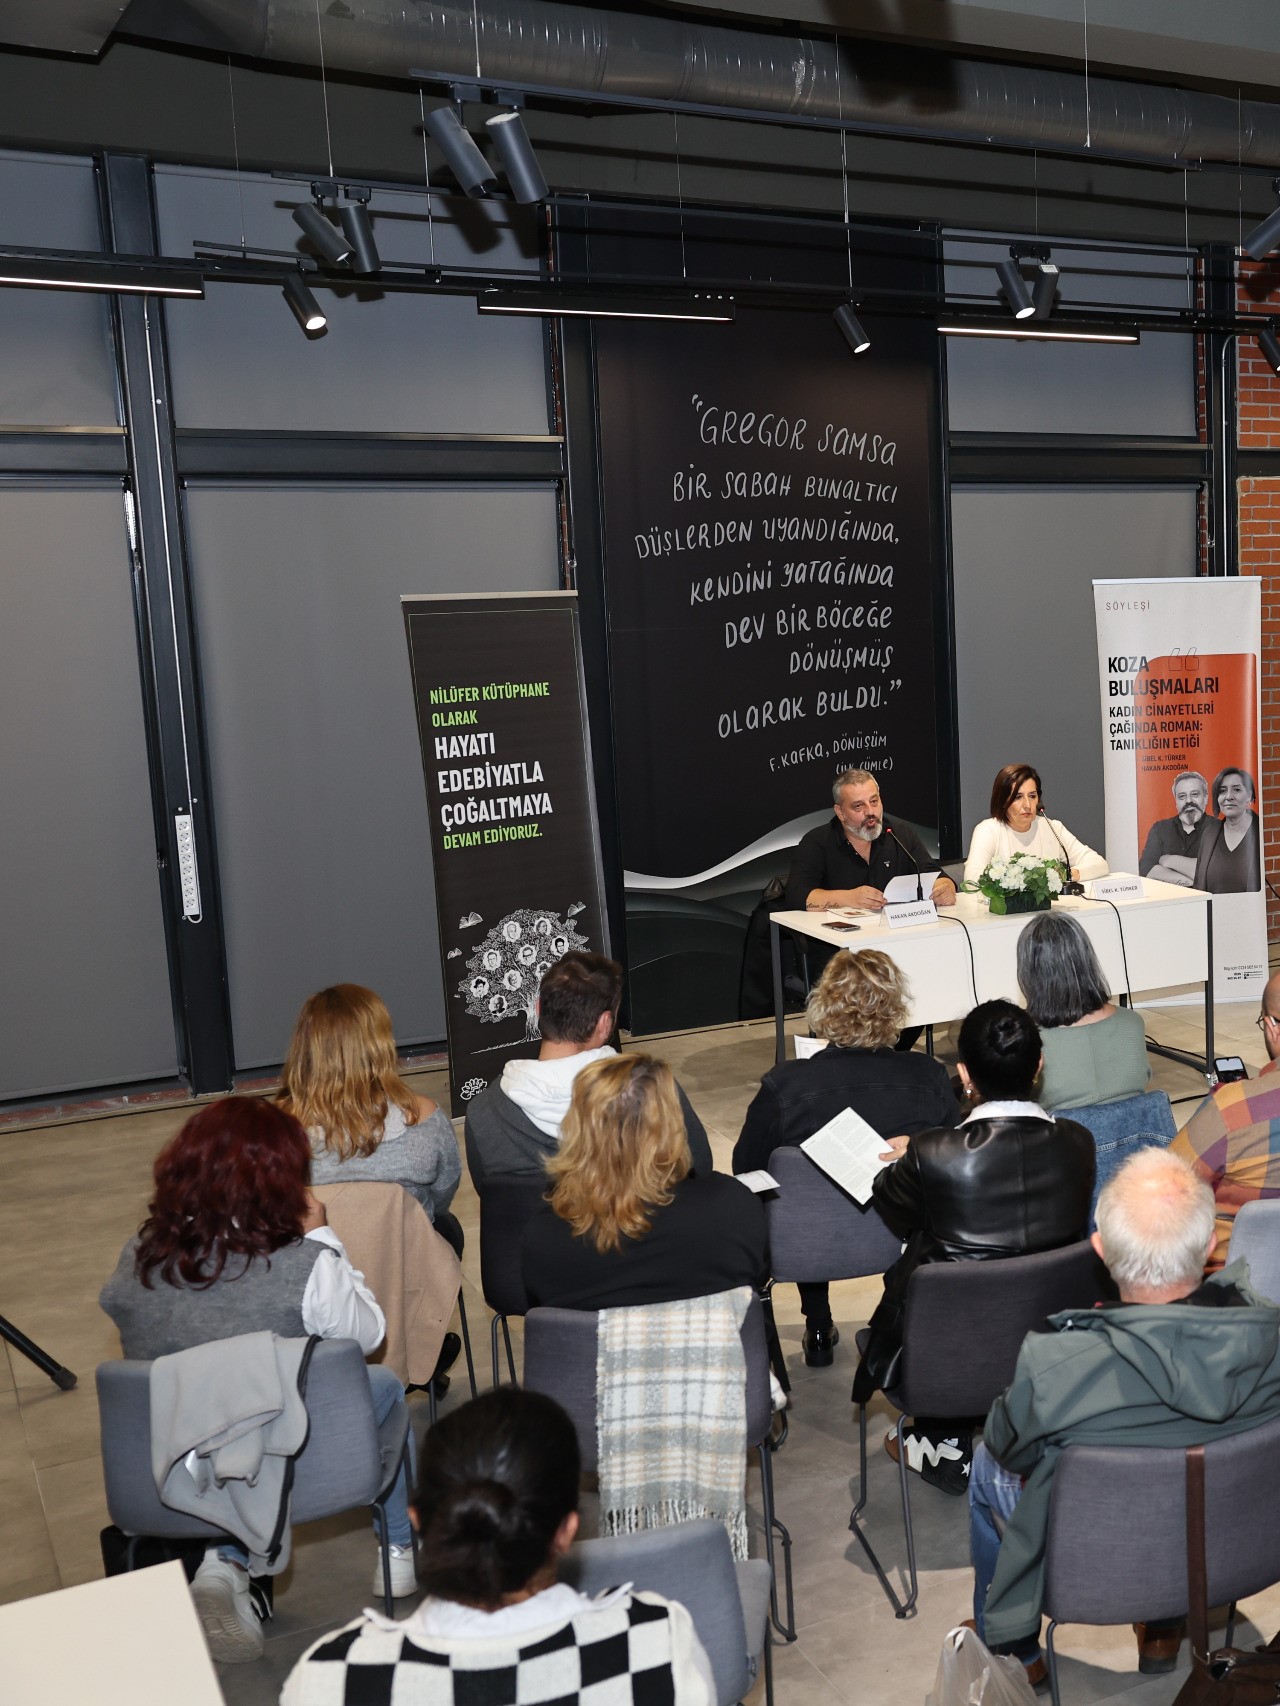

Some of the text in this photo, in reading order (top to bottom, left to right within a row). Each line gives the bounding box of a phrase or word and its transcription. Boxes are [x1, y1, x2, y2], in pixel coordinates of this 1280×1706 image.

[1105, 601, 1150, 612] SÖYLEŞİ
[1108, 656, 1150, 673] KOZA
[430, 682, 549, 704] NİLÜFER KÜTÜPHANE
[1108, 677, 1219, 700] BULUŞMALARI
[1109, 701, 1214, 718] KADIN CİNAYETLERİ
[432, 710, 478, 727] OLARAK
[1110, 720, 1203, 737] ÇAĞINDA ROMAN:
[435, 733, 495, 759] HAYATI
[1110, 734, 1200, 750] TANIKLIĞIN ETİĞİ
[1165, 753, 1186, 761] TÜRKER
[1162, 763, 1189, 771] AKDOĞAN
[438, 761, 544, 793] EDEBİYATLA
[440, 791, 553, 832] ÇOĞALTMAYA
[444, 824, 542, 849] DEVAM EDİYORUZ.
